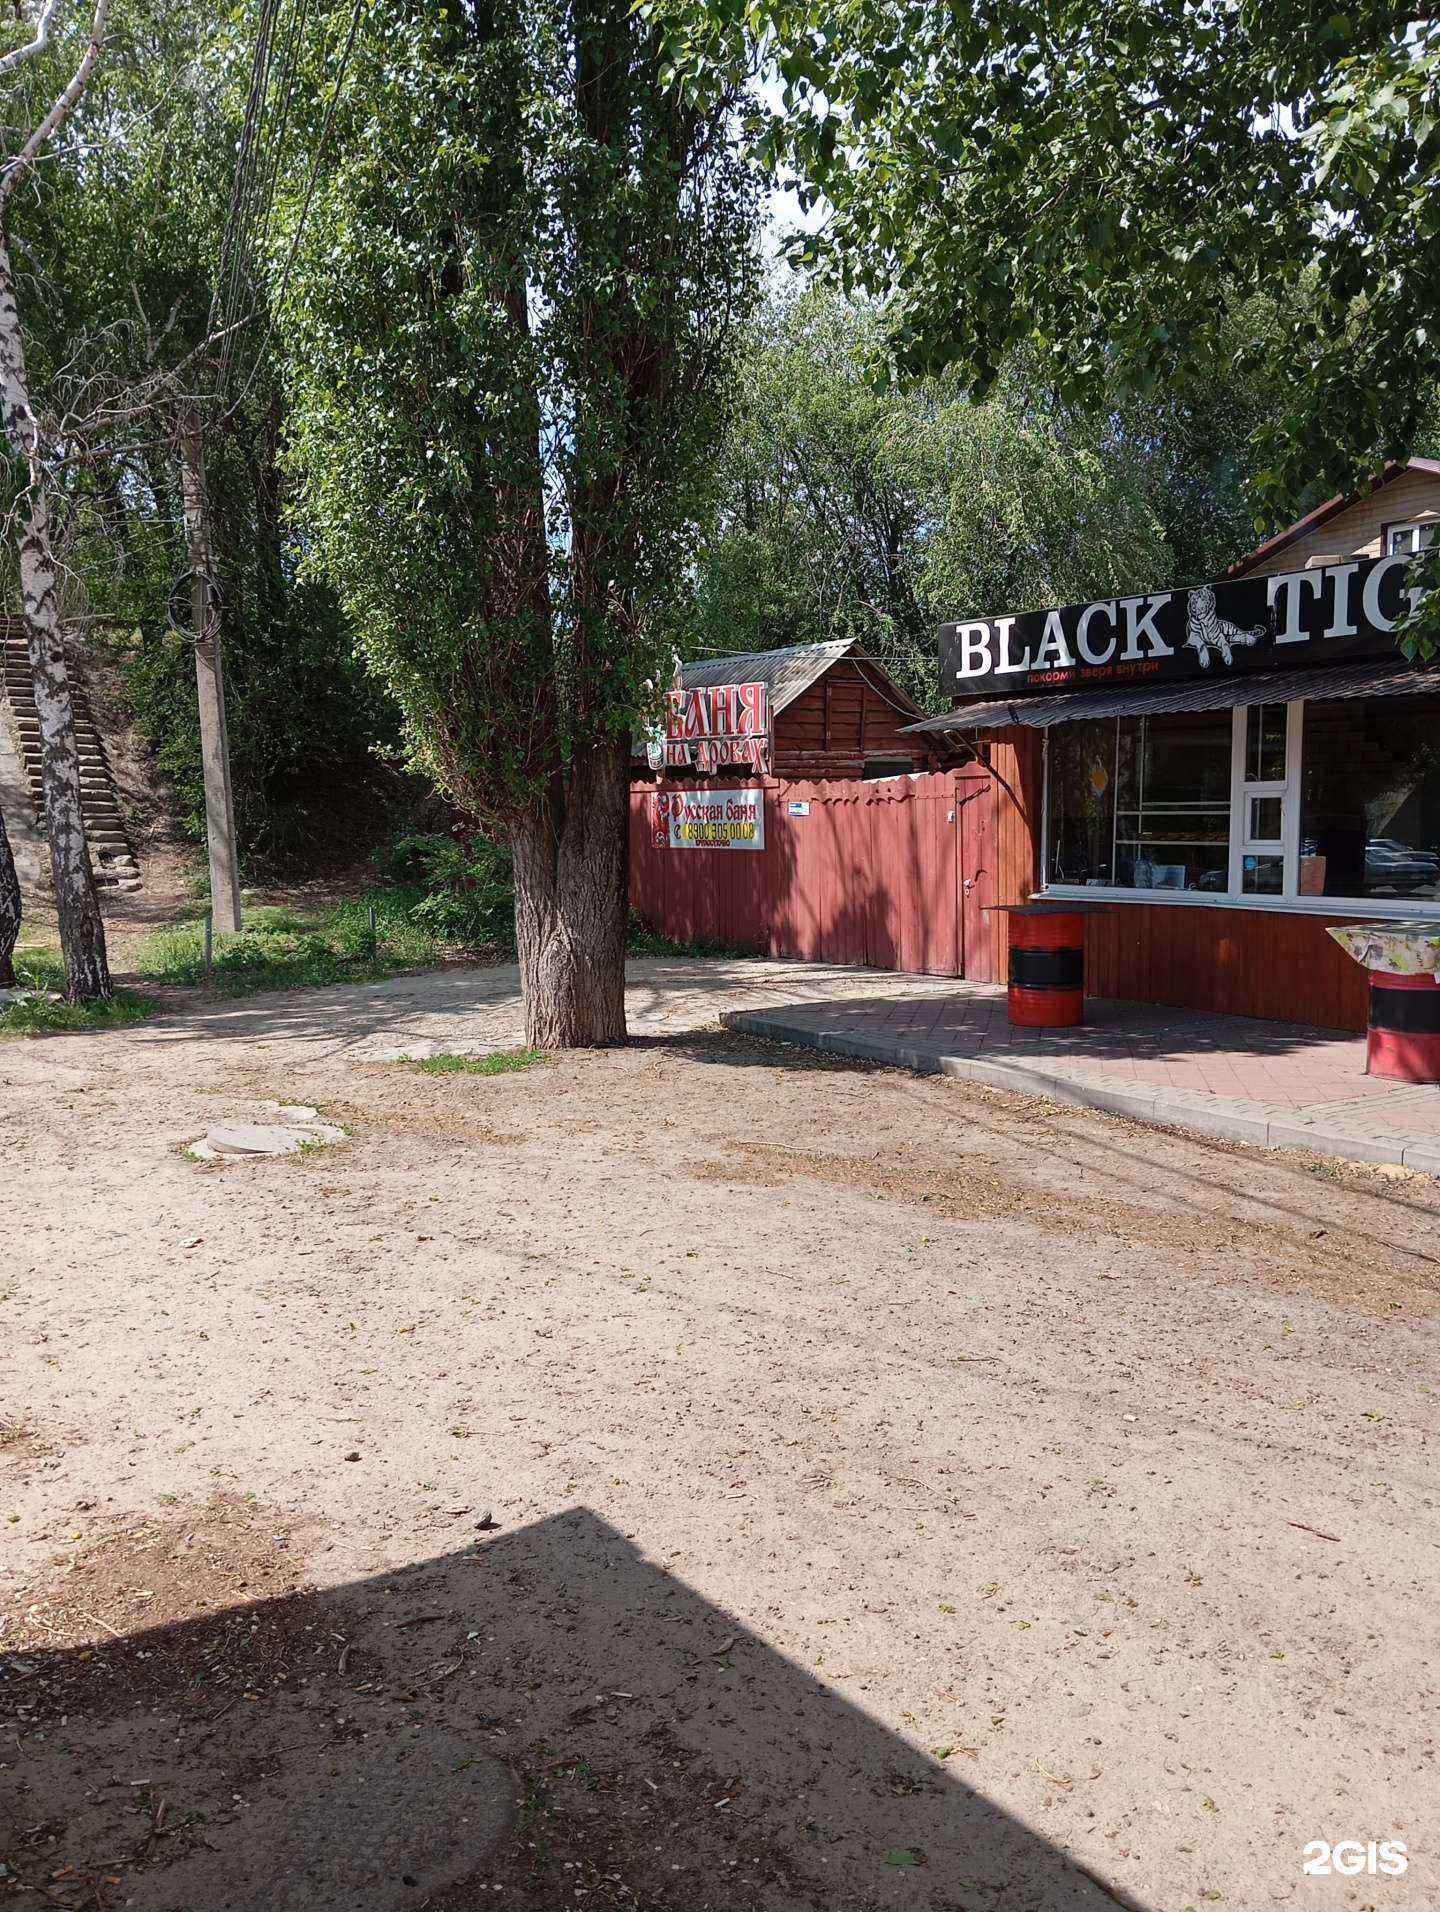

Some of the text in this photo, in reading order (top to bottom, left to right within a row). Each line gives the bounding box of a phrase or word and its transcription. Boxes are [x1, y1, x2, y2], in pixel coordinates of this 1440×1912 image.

[955, 554, 1440, 679] BLACK TIG
[1027, 671, 1075, 684] покорми
[1116, 661, 1160, 677] внутри
[664, 682, 765, 740] БАНЯ
[671, 793, 723, 825] Русская
[727, 798, 757, 821] баня
[688, 822, 709, 840] 8900
[712, 822, 728, 840] 305
